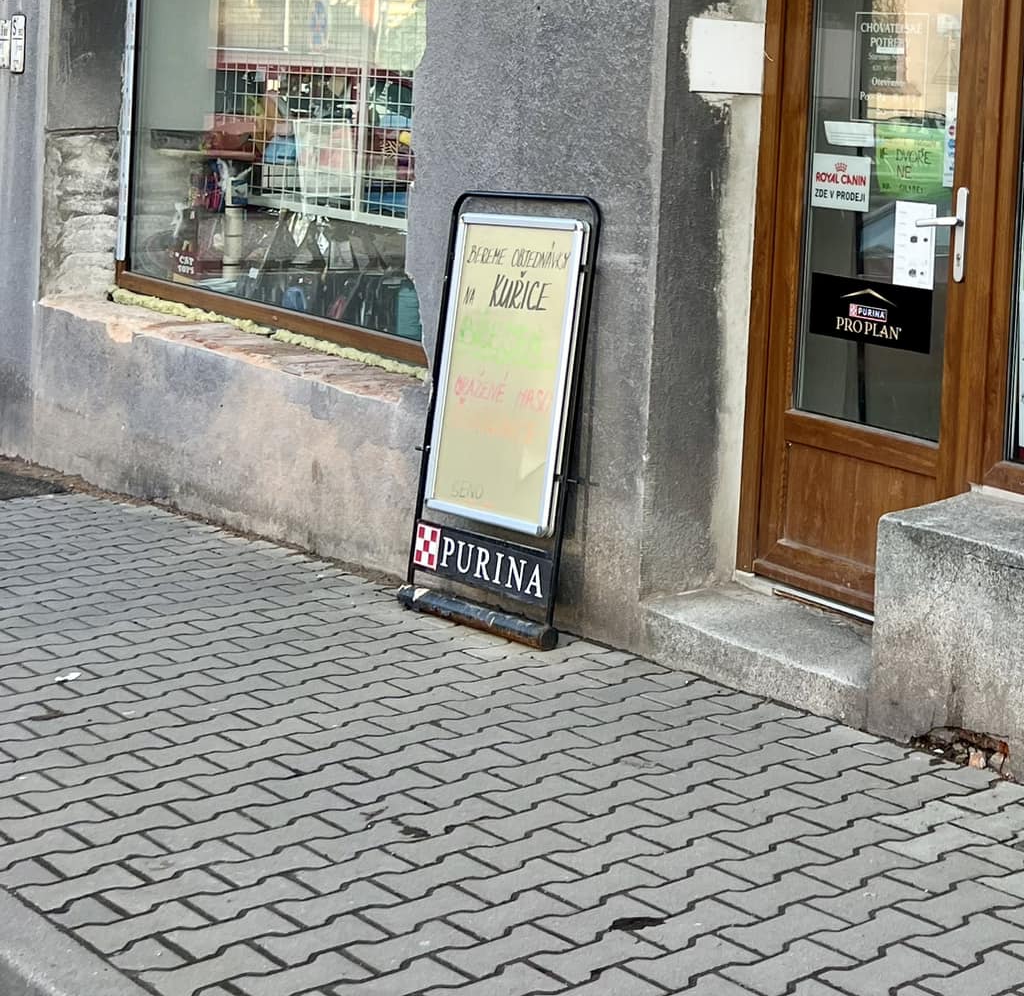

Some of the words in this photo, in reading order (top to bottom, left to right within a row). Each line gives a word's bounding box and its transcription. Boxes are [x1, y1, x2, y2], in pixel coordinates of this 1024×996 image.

[815, 171, 840, 184] ROYAL
[840, 174, 867, 187] CANIN
[814, 188, 828, 199] ZDE
[829, 190, 835, 199] V
[836, 190, 866, 203] PRODEJI
[466, 244, 508, 265] BEREME
[488, 270, 553, 311] KUŘICE
[857, 307, 885, 319] PURINA
[835, 316, 863, 334] PRO
[439, 536, 543, 599] PURINA
